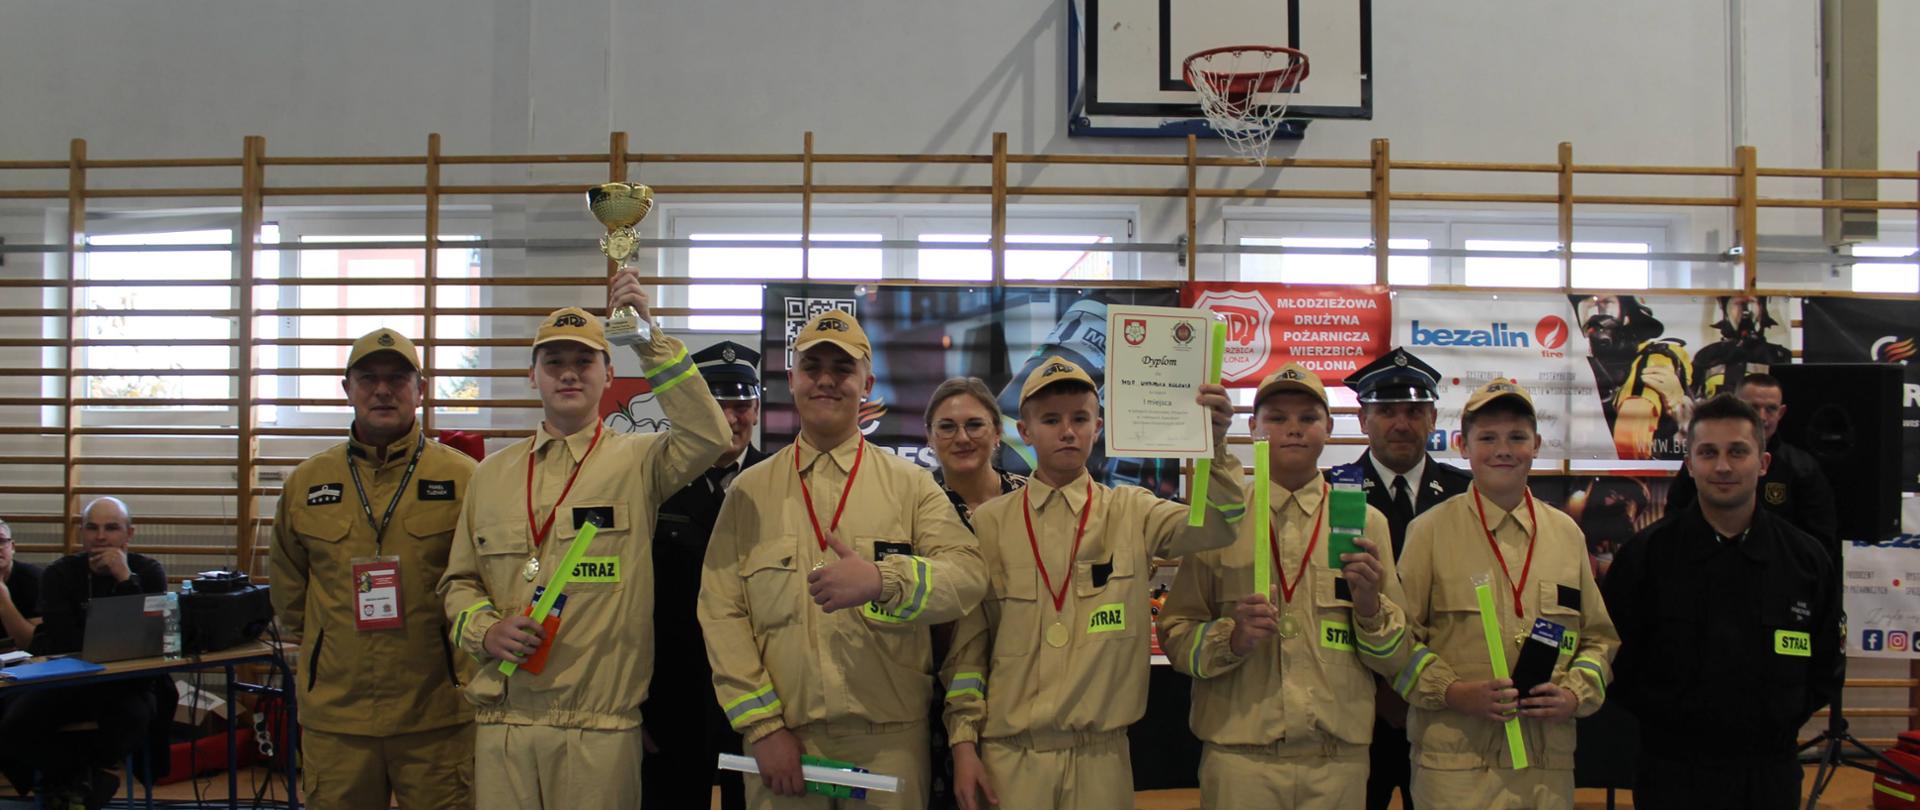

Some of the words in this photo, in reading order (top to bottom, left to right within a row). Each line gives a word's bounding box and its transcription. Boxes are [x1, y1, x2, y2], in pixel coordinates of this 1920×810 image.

[1277, 297, 1377, 309] MŁODZIEŻOWA
[1294, 313, 1360, 325] DRUŻYNA
[1283, 329, 1370, 342] POŻARNICZA
[1411, 320, 1529, 348] bezalin
[1289, 346, 1364, 356] WIERZBICA
[1541, 350, 1564, 358] fire
[1142, 356, 1177, 368] Dyplom
[1147, 399, 1172, 407] miejsca
